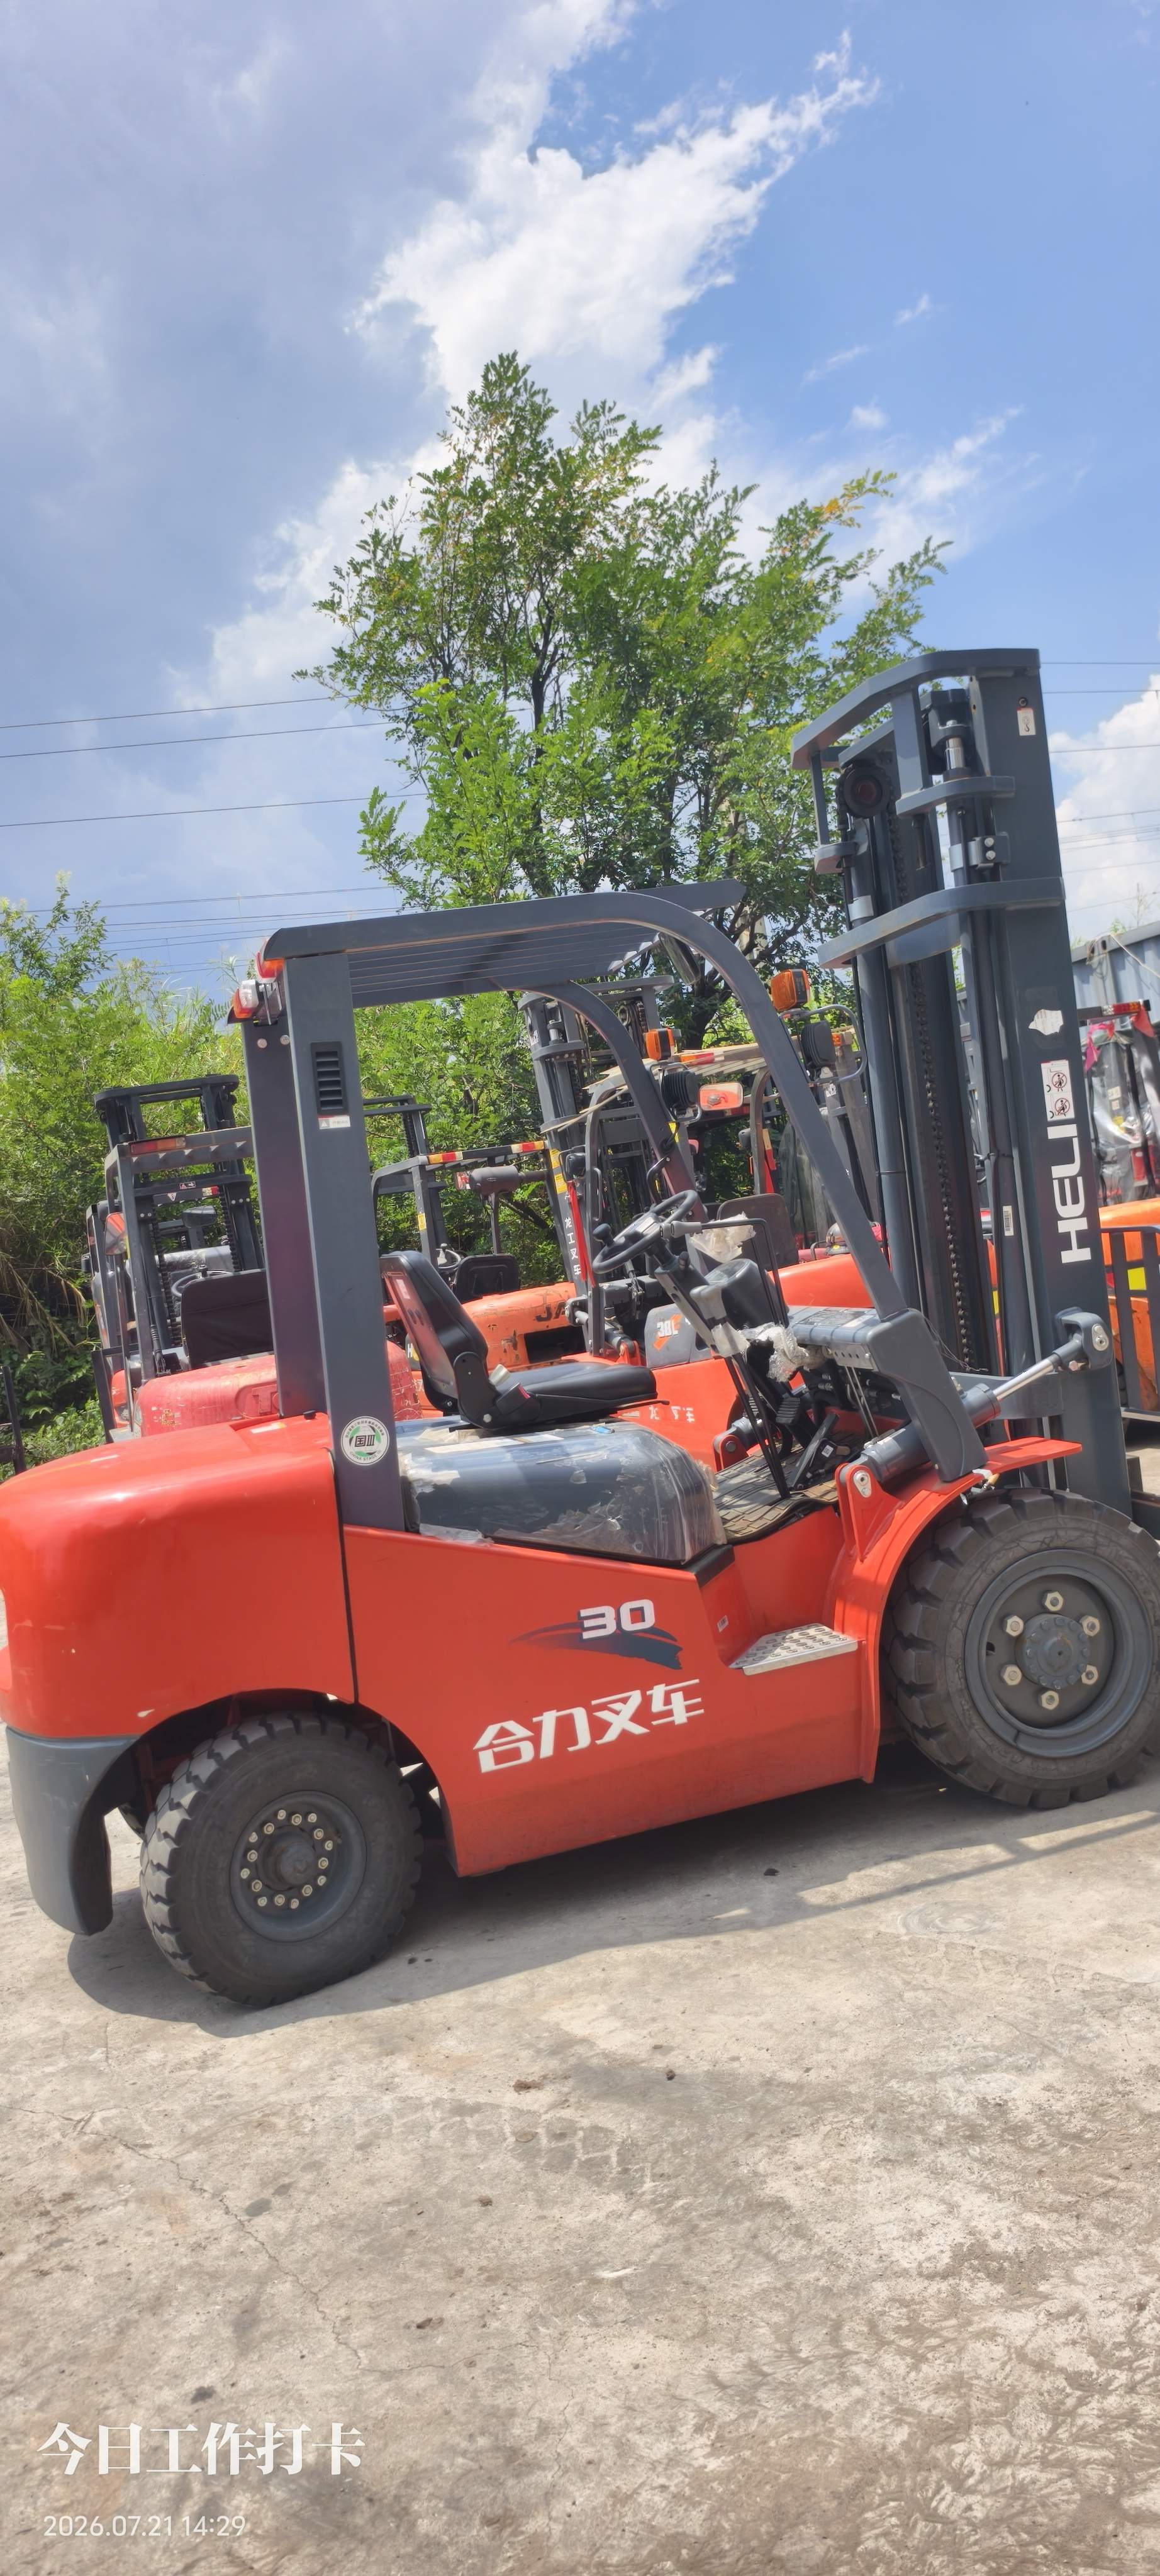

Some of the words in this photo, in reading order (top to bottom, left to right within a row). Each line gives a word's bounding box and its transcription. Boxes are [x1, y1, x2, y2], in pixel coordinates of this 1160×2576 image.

[1047, 1123, 1092, 1264] HELI
[577, 1599, 655, 1640] 30
[472, 1679, 705, 1774] 合力叉车
